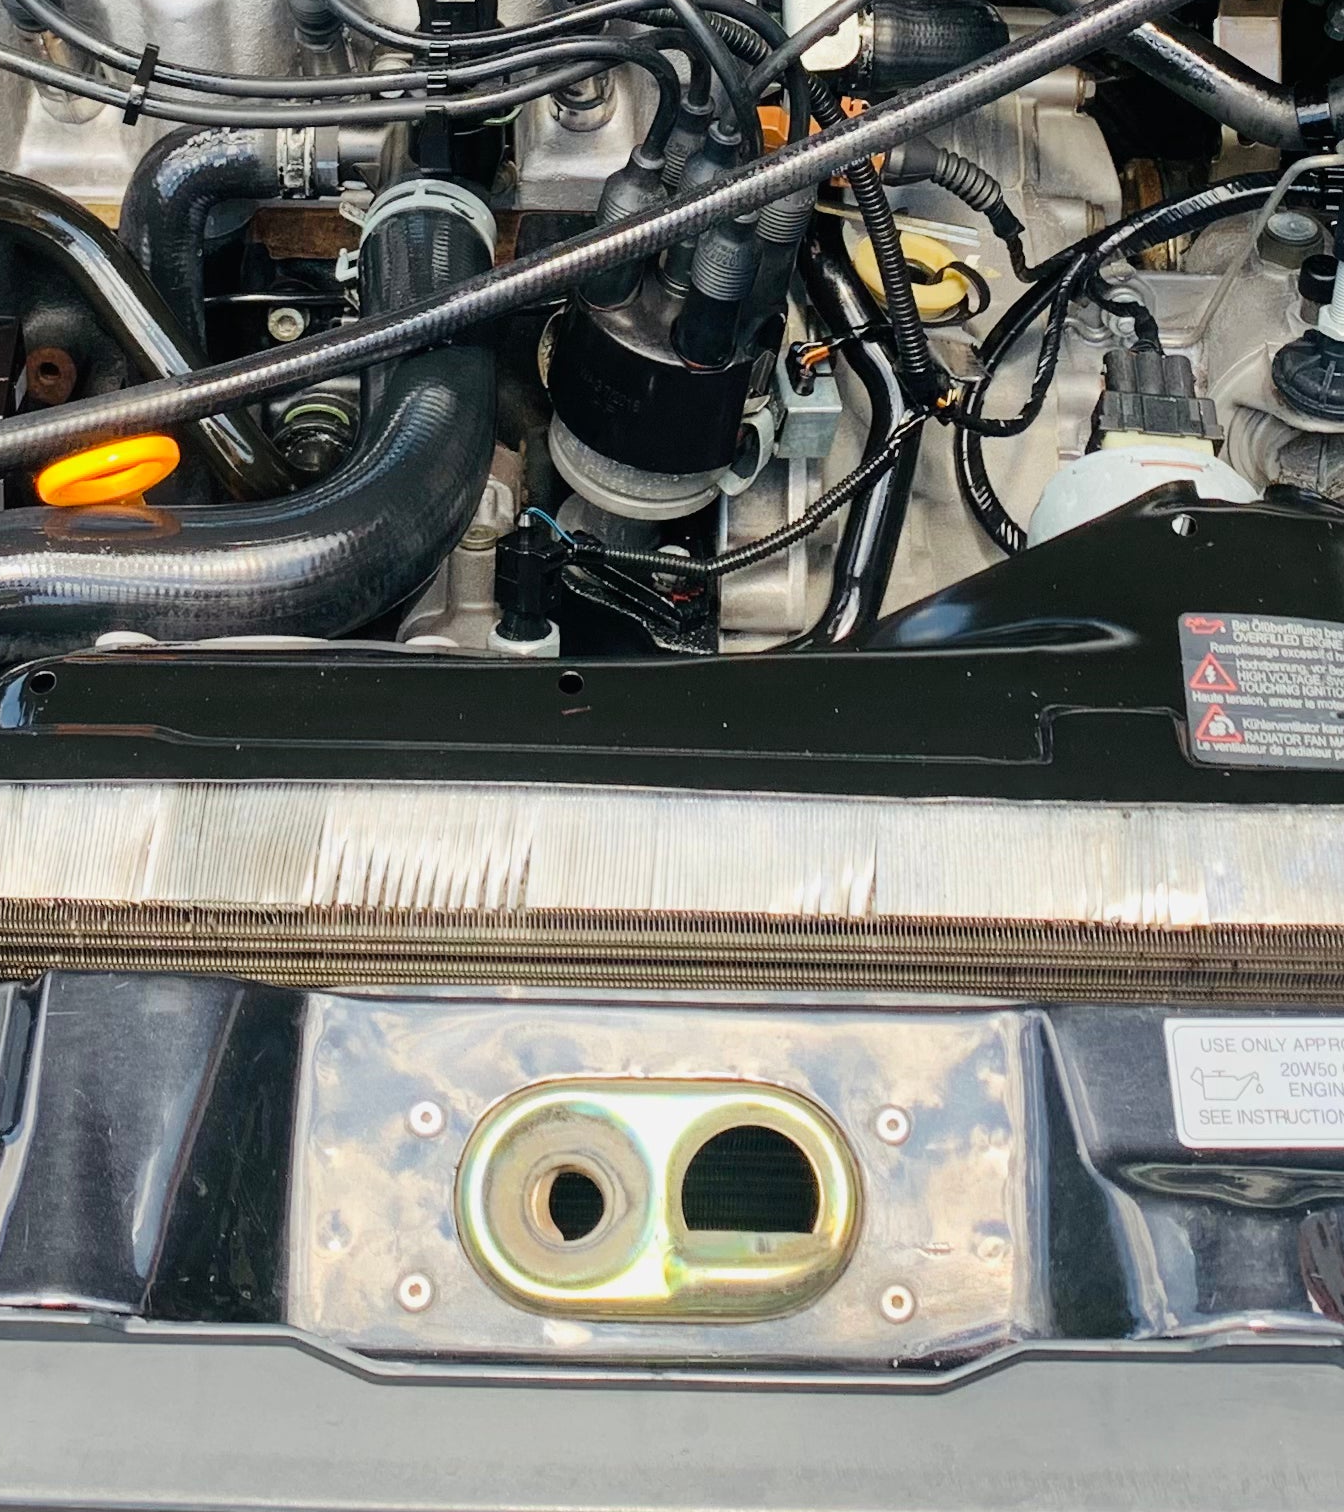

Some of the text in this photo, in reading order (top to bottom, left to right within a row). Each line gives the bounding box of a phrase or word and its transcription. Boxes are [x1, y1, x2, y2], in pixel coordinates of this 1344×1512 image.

[1231, 619, 1250, 632] Bei
[1233, 631, 1300, 646] OVERFILLED
[1302, 634, 1343, 650] ENGINE
[1209, 642, 1279, 659] Remplissage
[1237, 670, 1267, 682] HIGH
[1240, 682, 1300, 696] TOUCHING
[1191, 691, 1224, 704] Haute
[1244, 731, 1302, 745] RADIATOR
[1303, 734, 1327, 747] FAN
[1269, 744, 1284, 756] de
[1285, 746, 1333, 759] radiateur
[1200, 1038, 1237, 1053] USE
[1241, 1038, 1287, 1053] ONLY
[1280, 1062, 1338, 1077] 20W50
[1199, 1109, 1233, 1125] SEE
